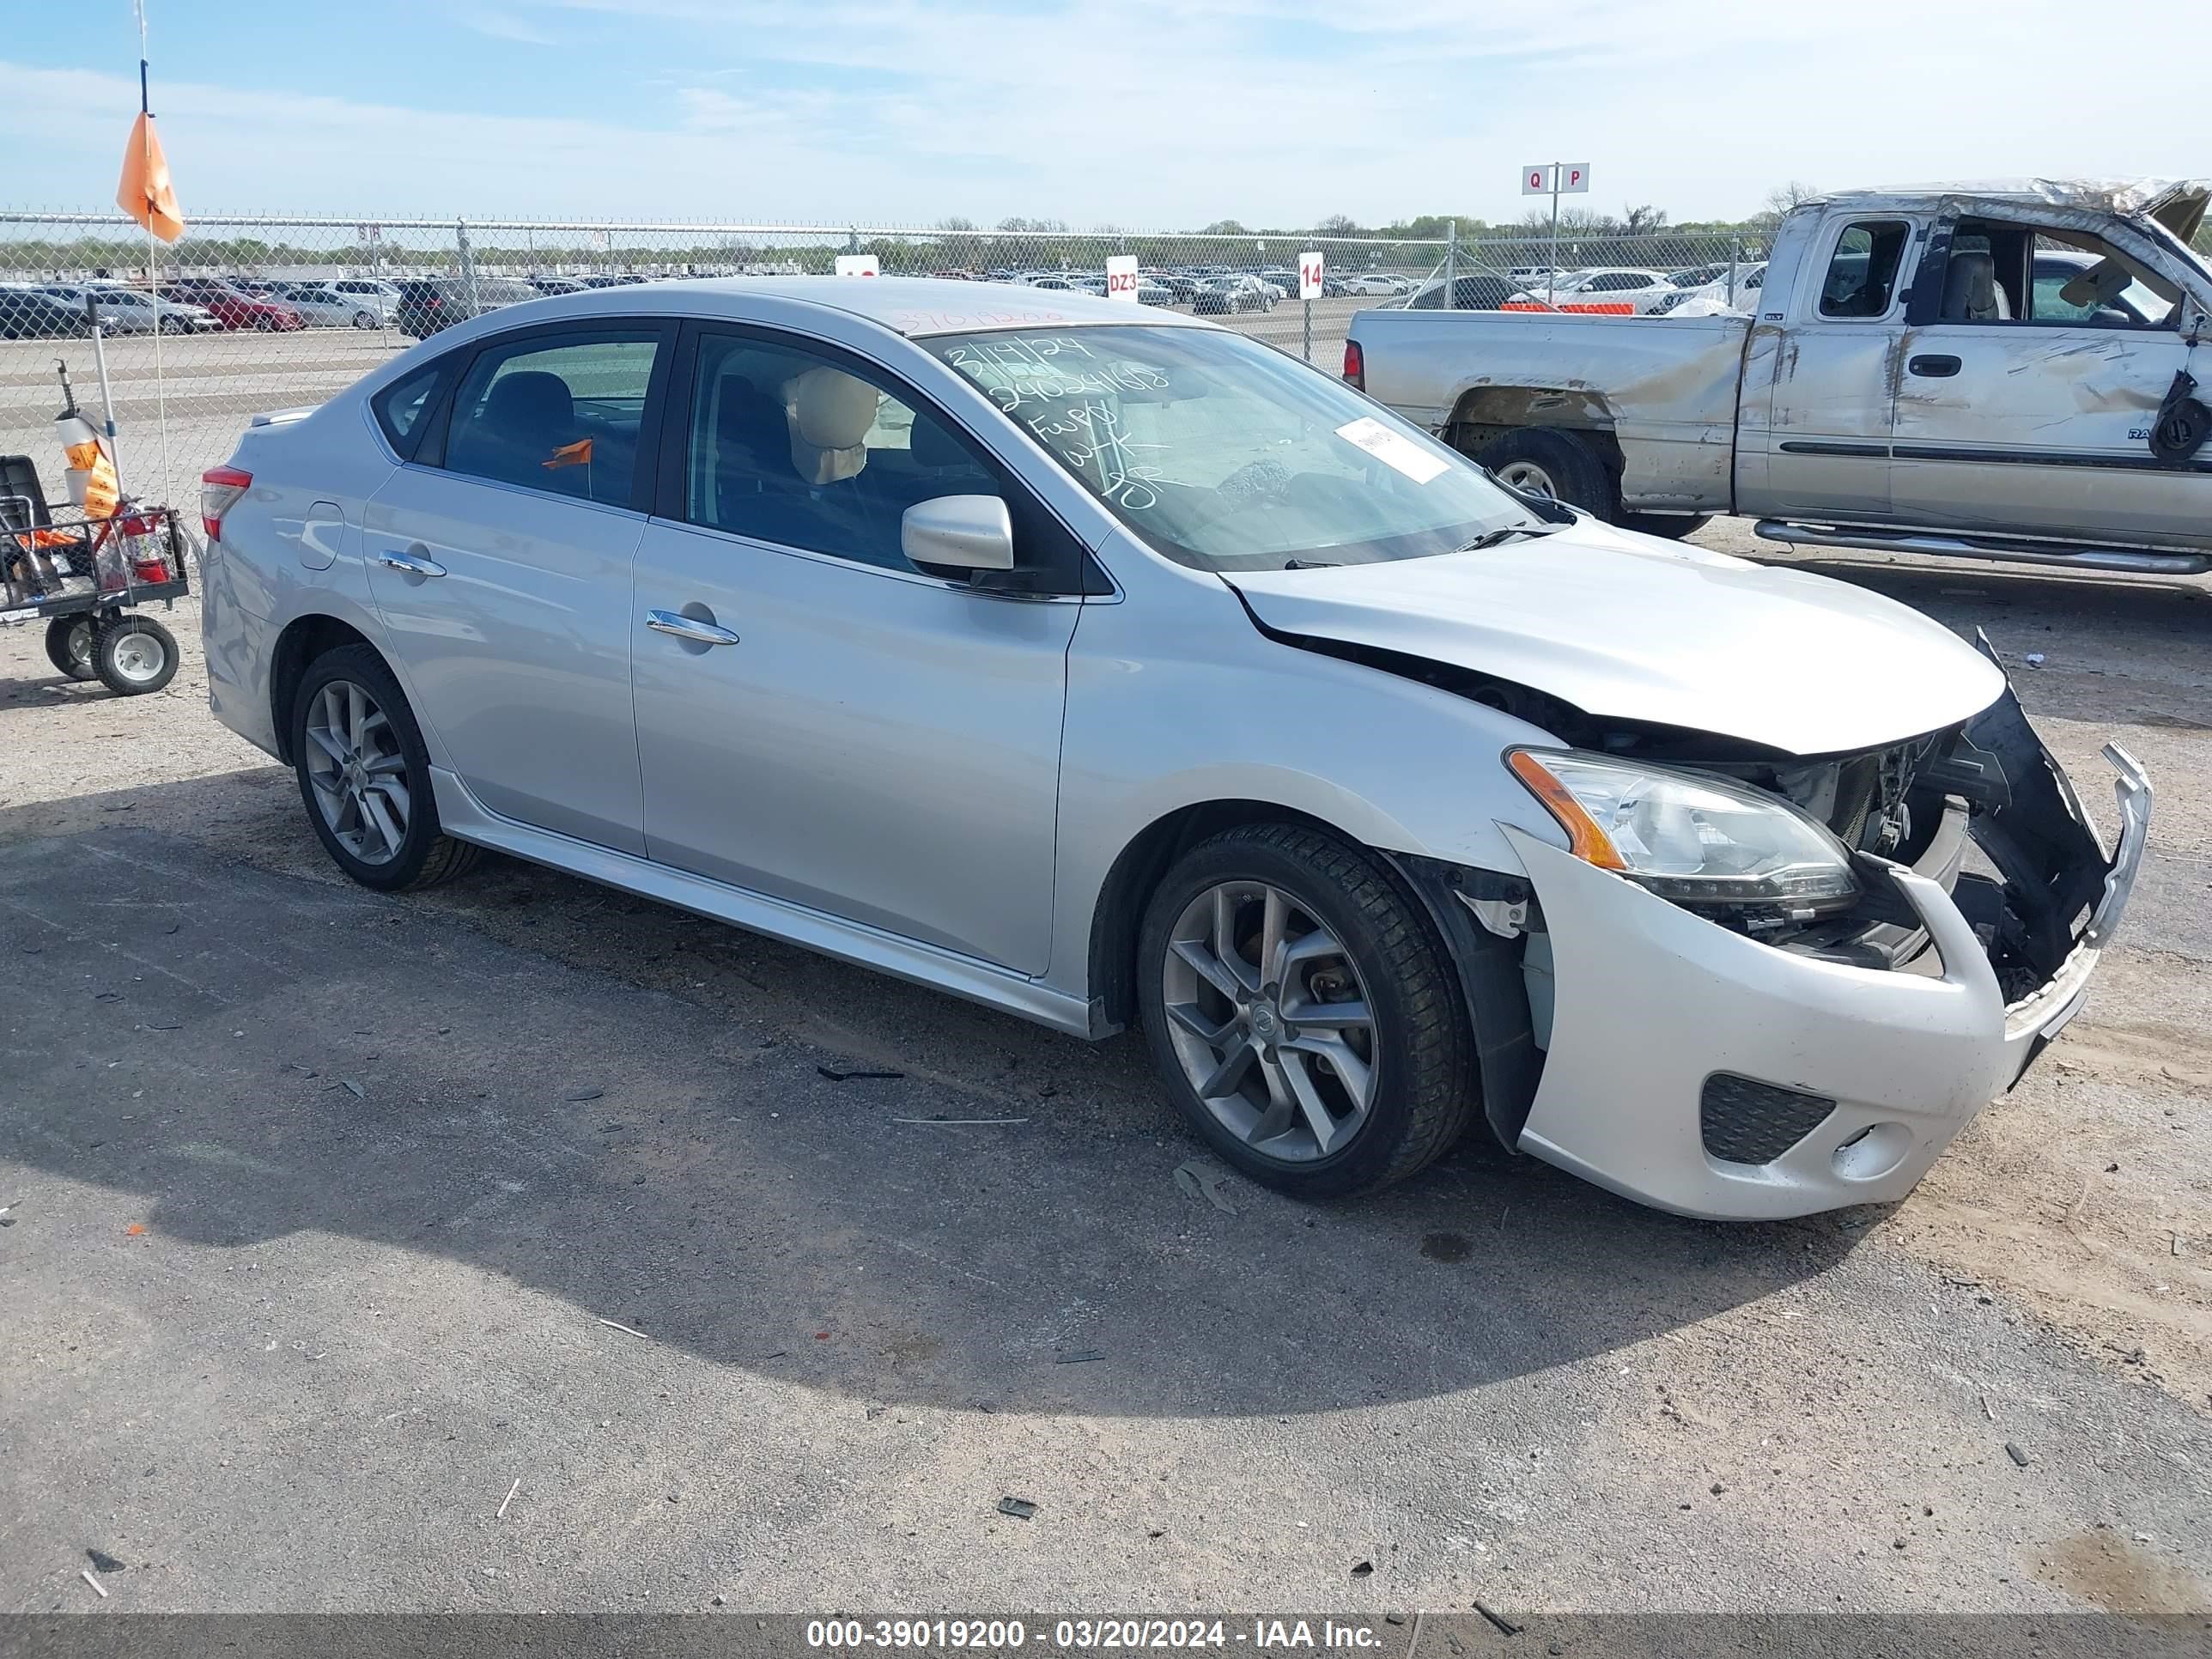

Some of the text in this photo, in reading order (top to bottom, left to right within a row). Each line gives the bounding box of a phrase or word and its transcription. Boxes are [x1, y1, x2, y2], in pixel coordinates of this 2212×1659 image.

[1530, 172, 1540, 188] Q
[1571, 170, 1580, 186] P
[1109, 273, 1137, 292] DZ3
[1302, 263, 1322, 288] 14
[947, 336, 1097, 378] 3/14/24
